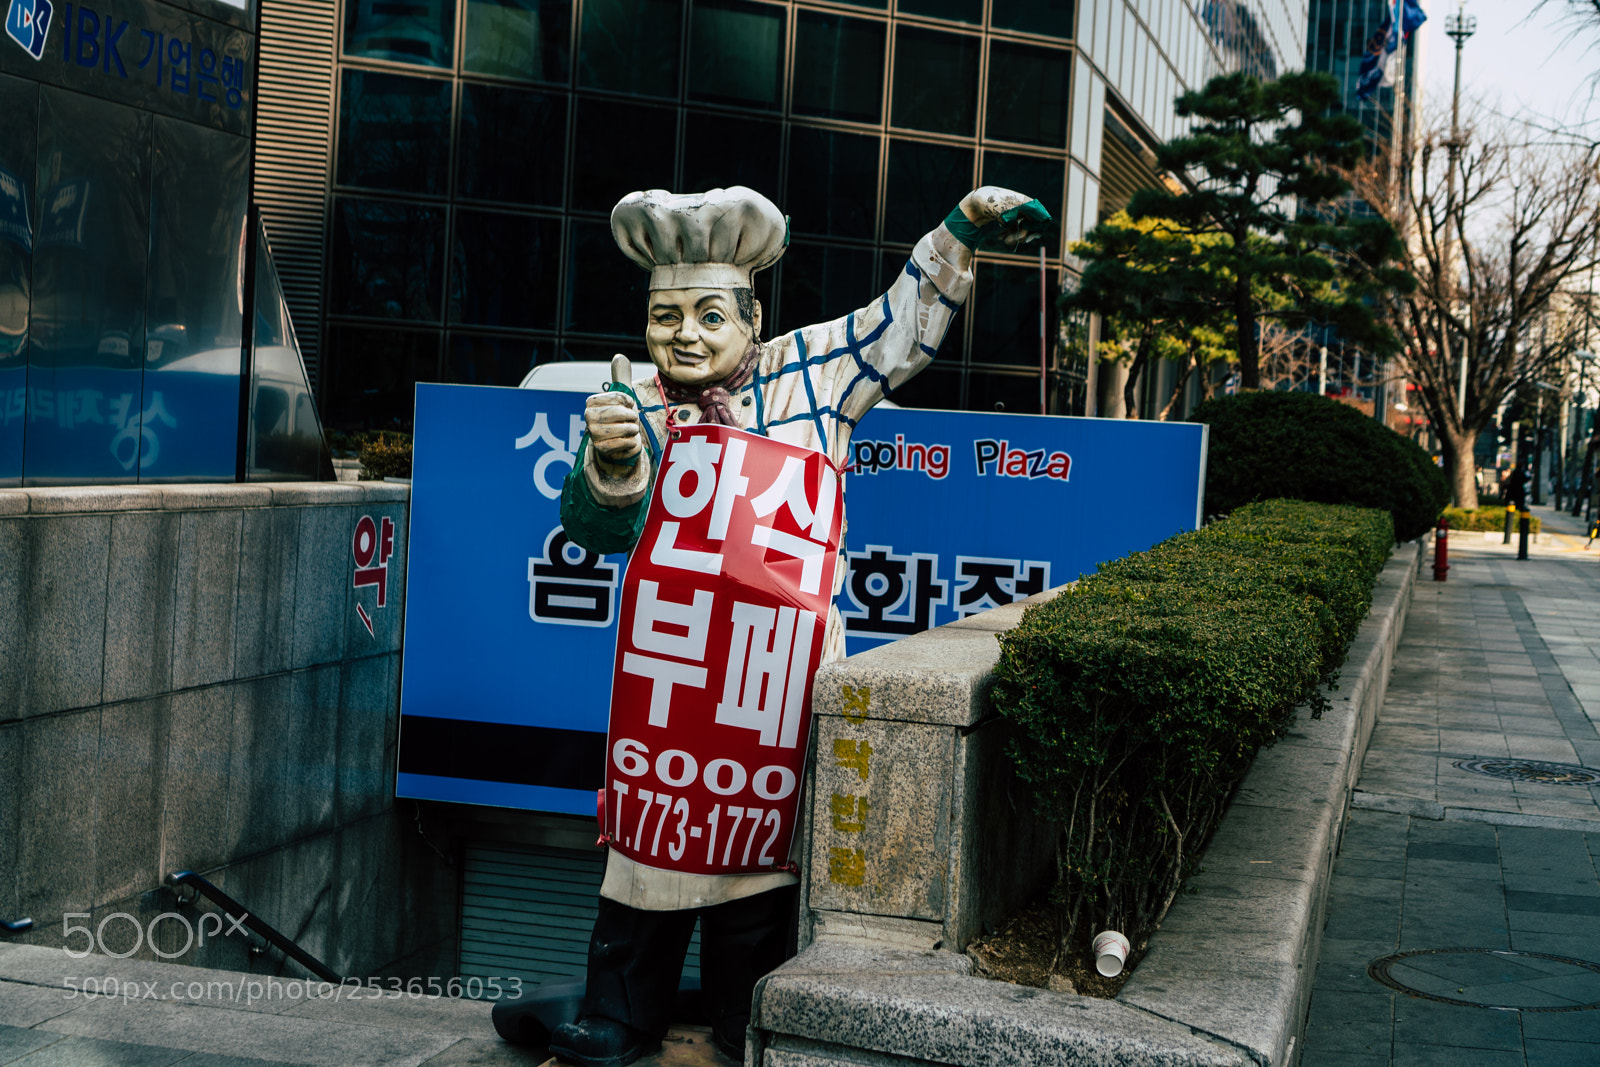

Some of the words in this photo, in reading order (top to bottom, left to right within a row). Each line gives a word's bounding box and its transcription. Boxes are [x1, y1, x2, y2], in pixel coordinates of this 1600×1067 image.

[62, 2, 130, 80] IBK
[138, 28, 244, 111] 기업은행
[973, 438, 1073, 483] Plaza
[352, 514, 395, 609] 약
[650, 434, 838, 596] 한식
[621, 578, 818, 749] 부페
[612, 738, 797, 801] 6000
[612, 779, 782, 867] T.773-1772
